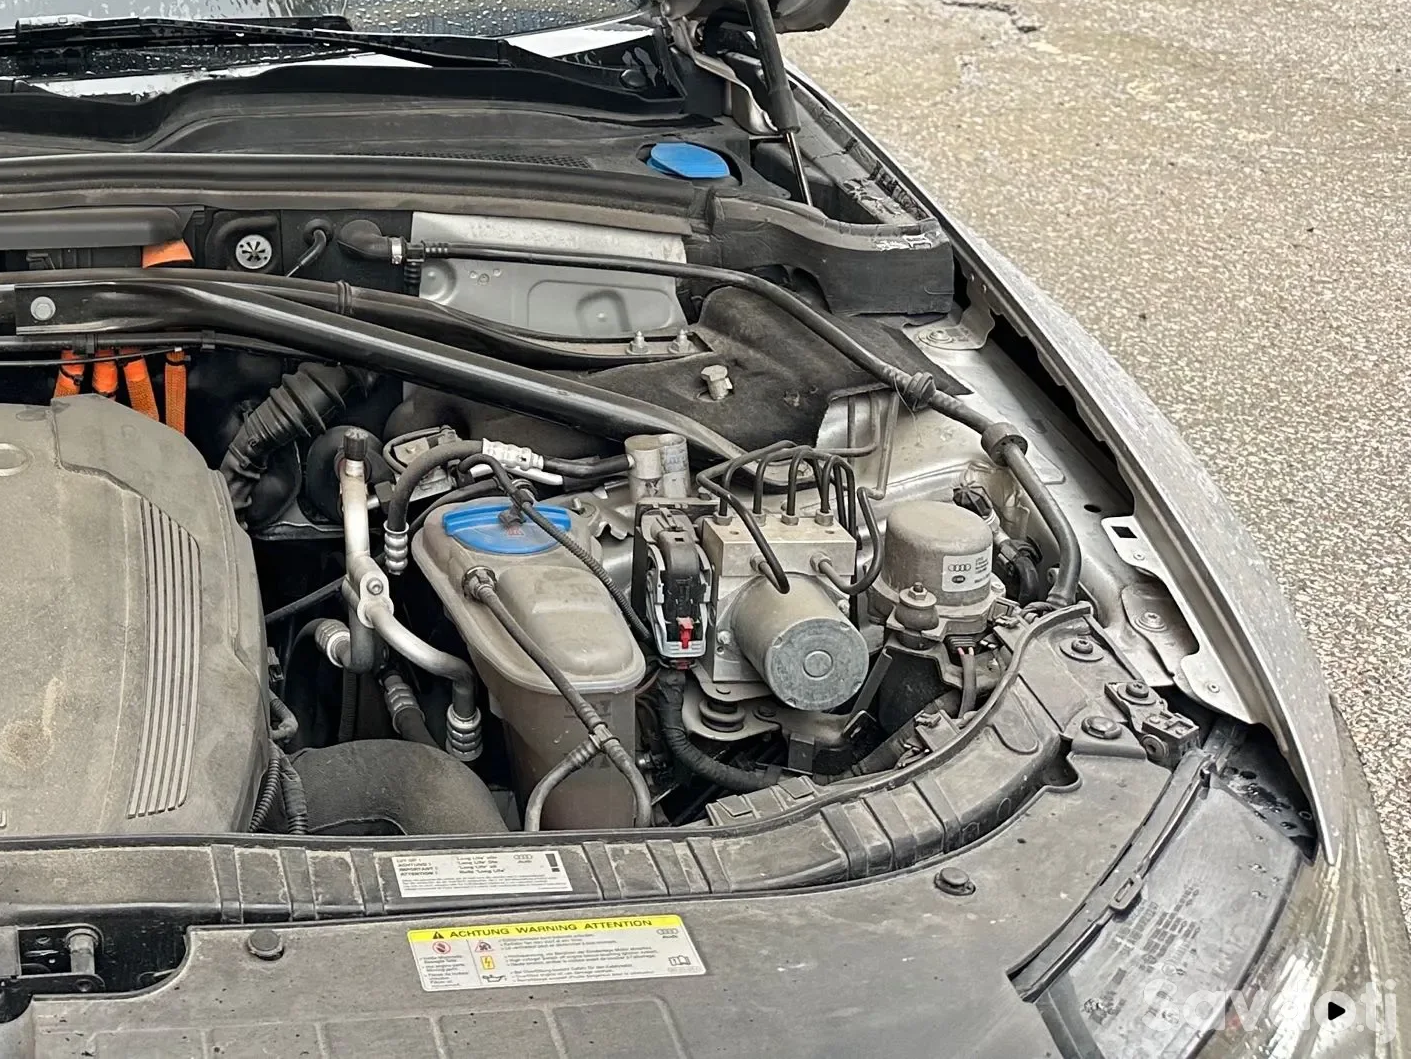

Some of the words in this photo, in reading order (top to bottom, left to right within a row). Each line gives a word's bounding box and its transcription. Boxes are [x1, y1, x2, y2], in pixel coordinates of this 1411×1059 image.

[449, 927, 510, 939] ACHTUNG
[515, 923, 578, 934] WARNING
[584, 919, 654, 931] ATTENTION
